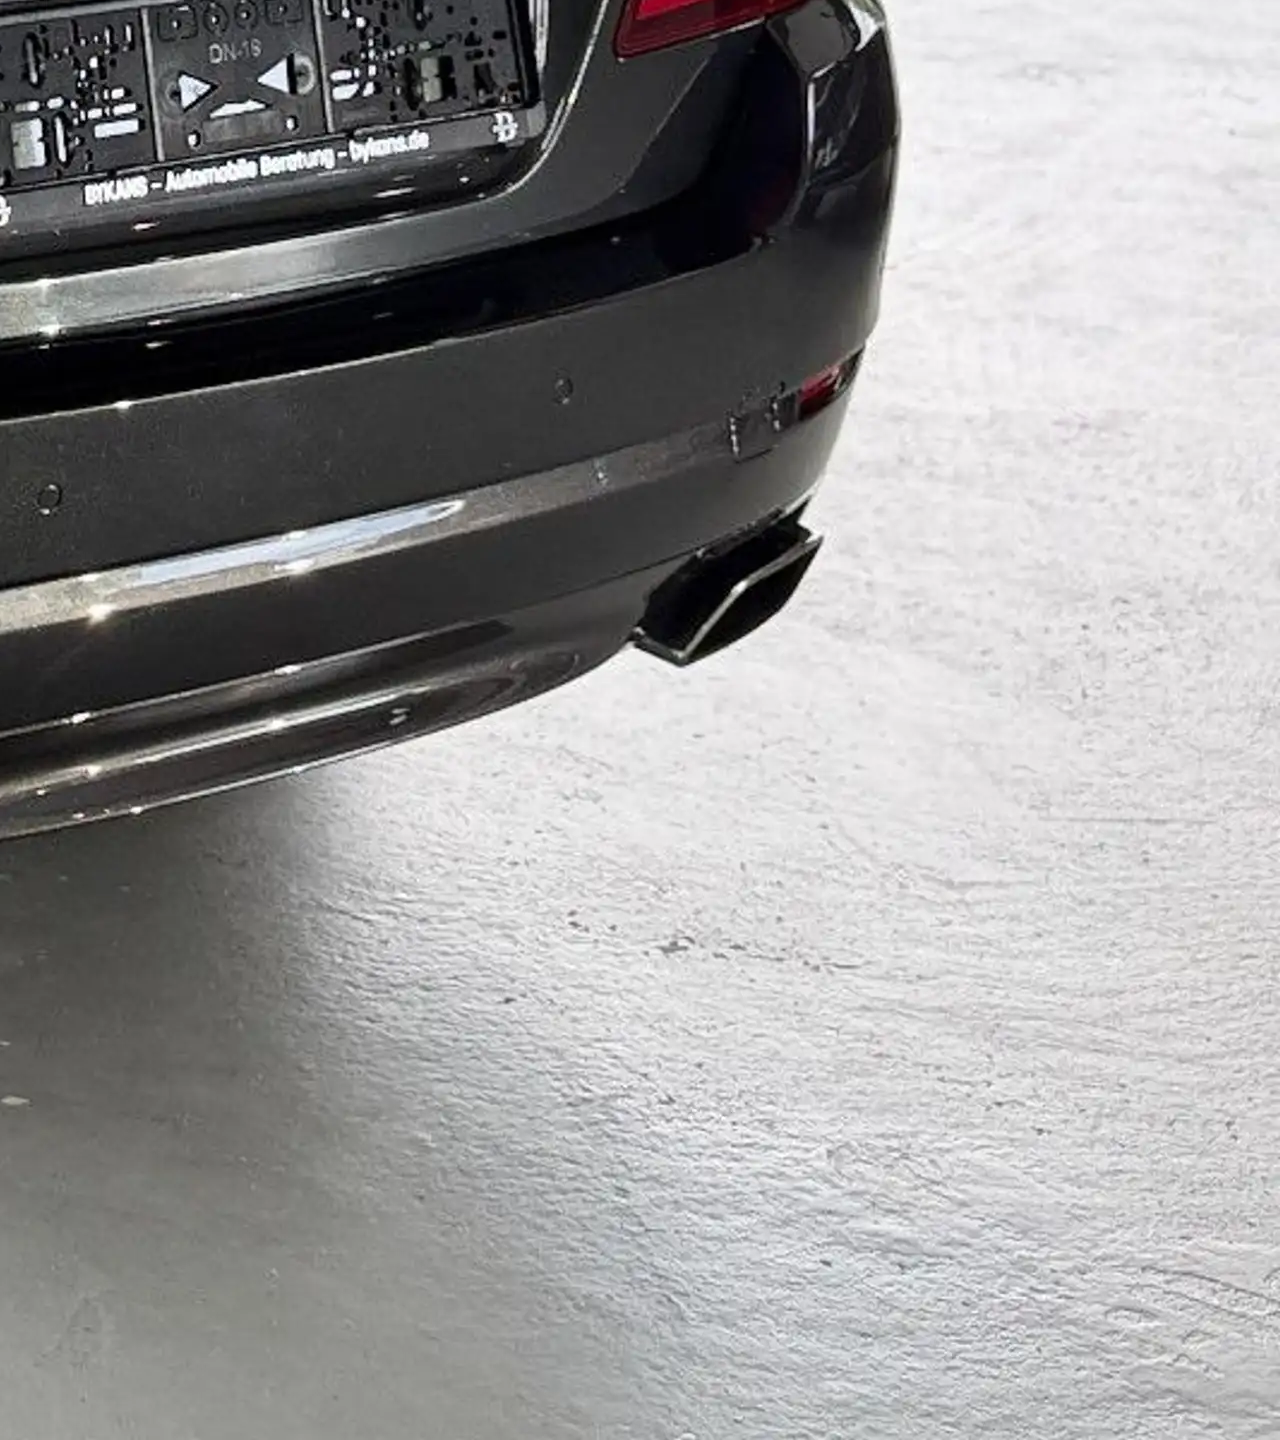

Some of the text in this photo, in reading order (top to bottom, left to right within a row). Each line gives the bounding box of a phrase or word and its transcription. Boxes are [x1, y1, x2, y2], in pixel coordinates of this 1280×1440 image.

[84, 174, 149, 206] BYKANS
[164, 157, 259, 193] Automobile
[260, 147, 336, 177] Beratung
[348, 128, 430, 164] bykans.de
